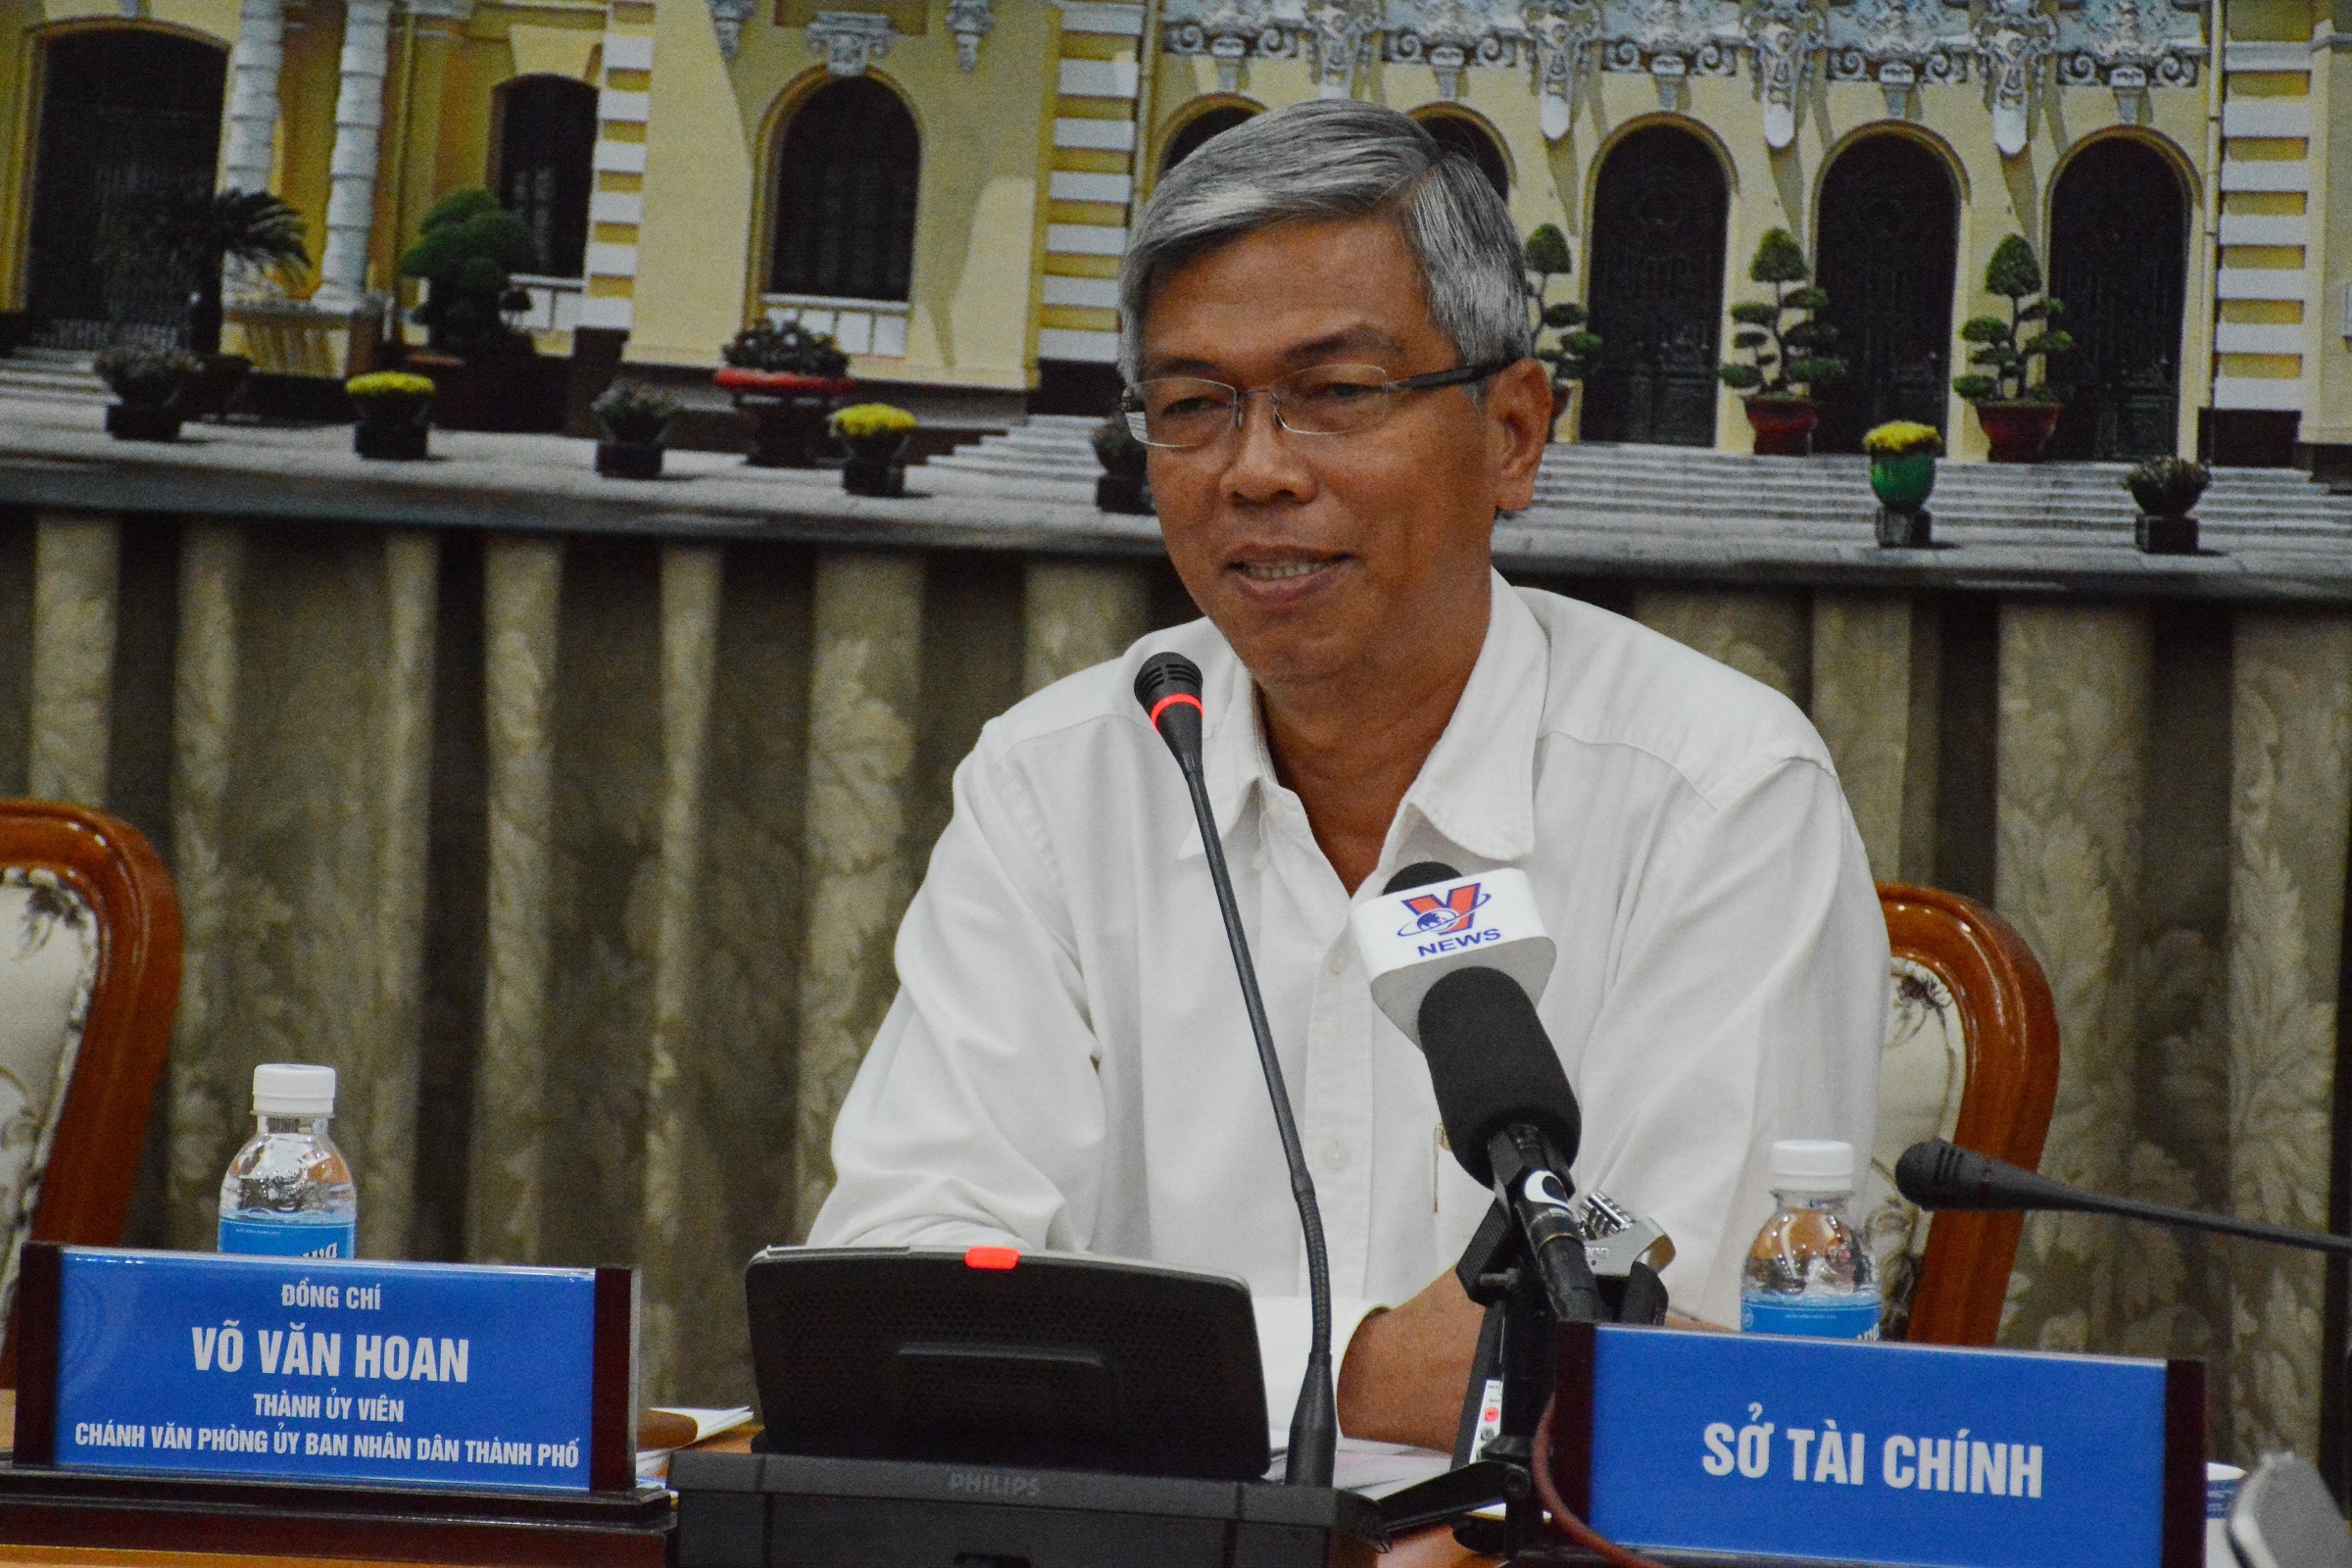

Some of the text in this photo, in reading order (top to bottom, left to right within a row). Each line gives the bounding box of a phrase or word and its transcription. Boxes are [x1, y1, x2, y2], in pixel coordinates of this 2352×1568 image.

[1417, 928, 1502, 957] NEWS
[280, 1277, 381, 1310] ĐỒNG CHÍ
[192, 1318, 469, 1383] VÕ VĂN HOAN
[253, 1387, 405, 1423] THÀNH ỦY VIÊN
[74, 1419, 580, 1468] CHÁNH VĂN PHÒNG ỦY BAN NHÂN DÂN THÀNH PHỐ
[1702, 1402, 2043, 1498] SỞ TÀI CHÍNH
[948, 1472, 1041, 1496] PHILIPS
